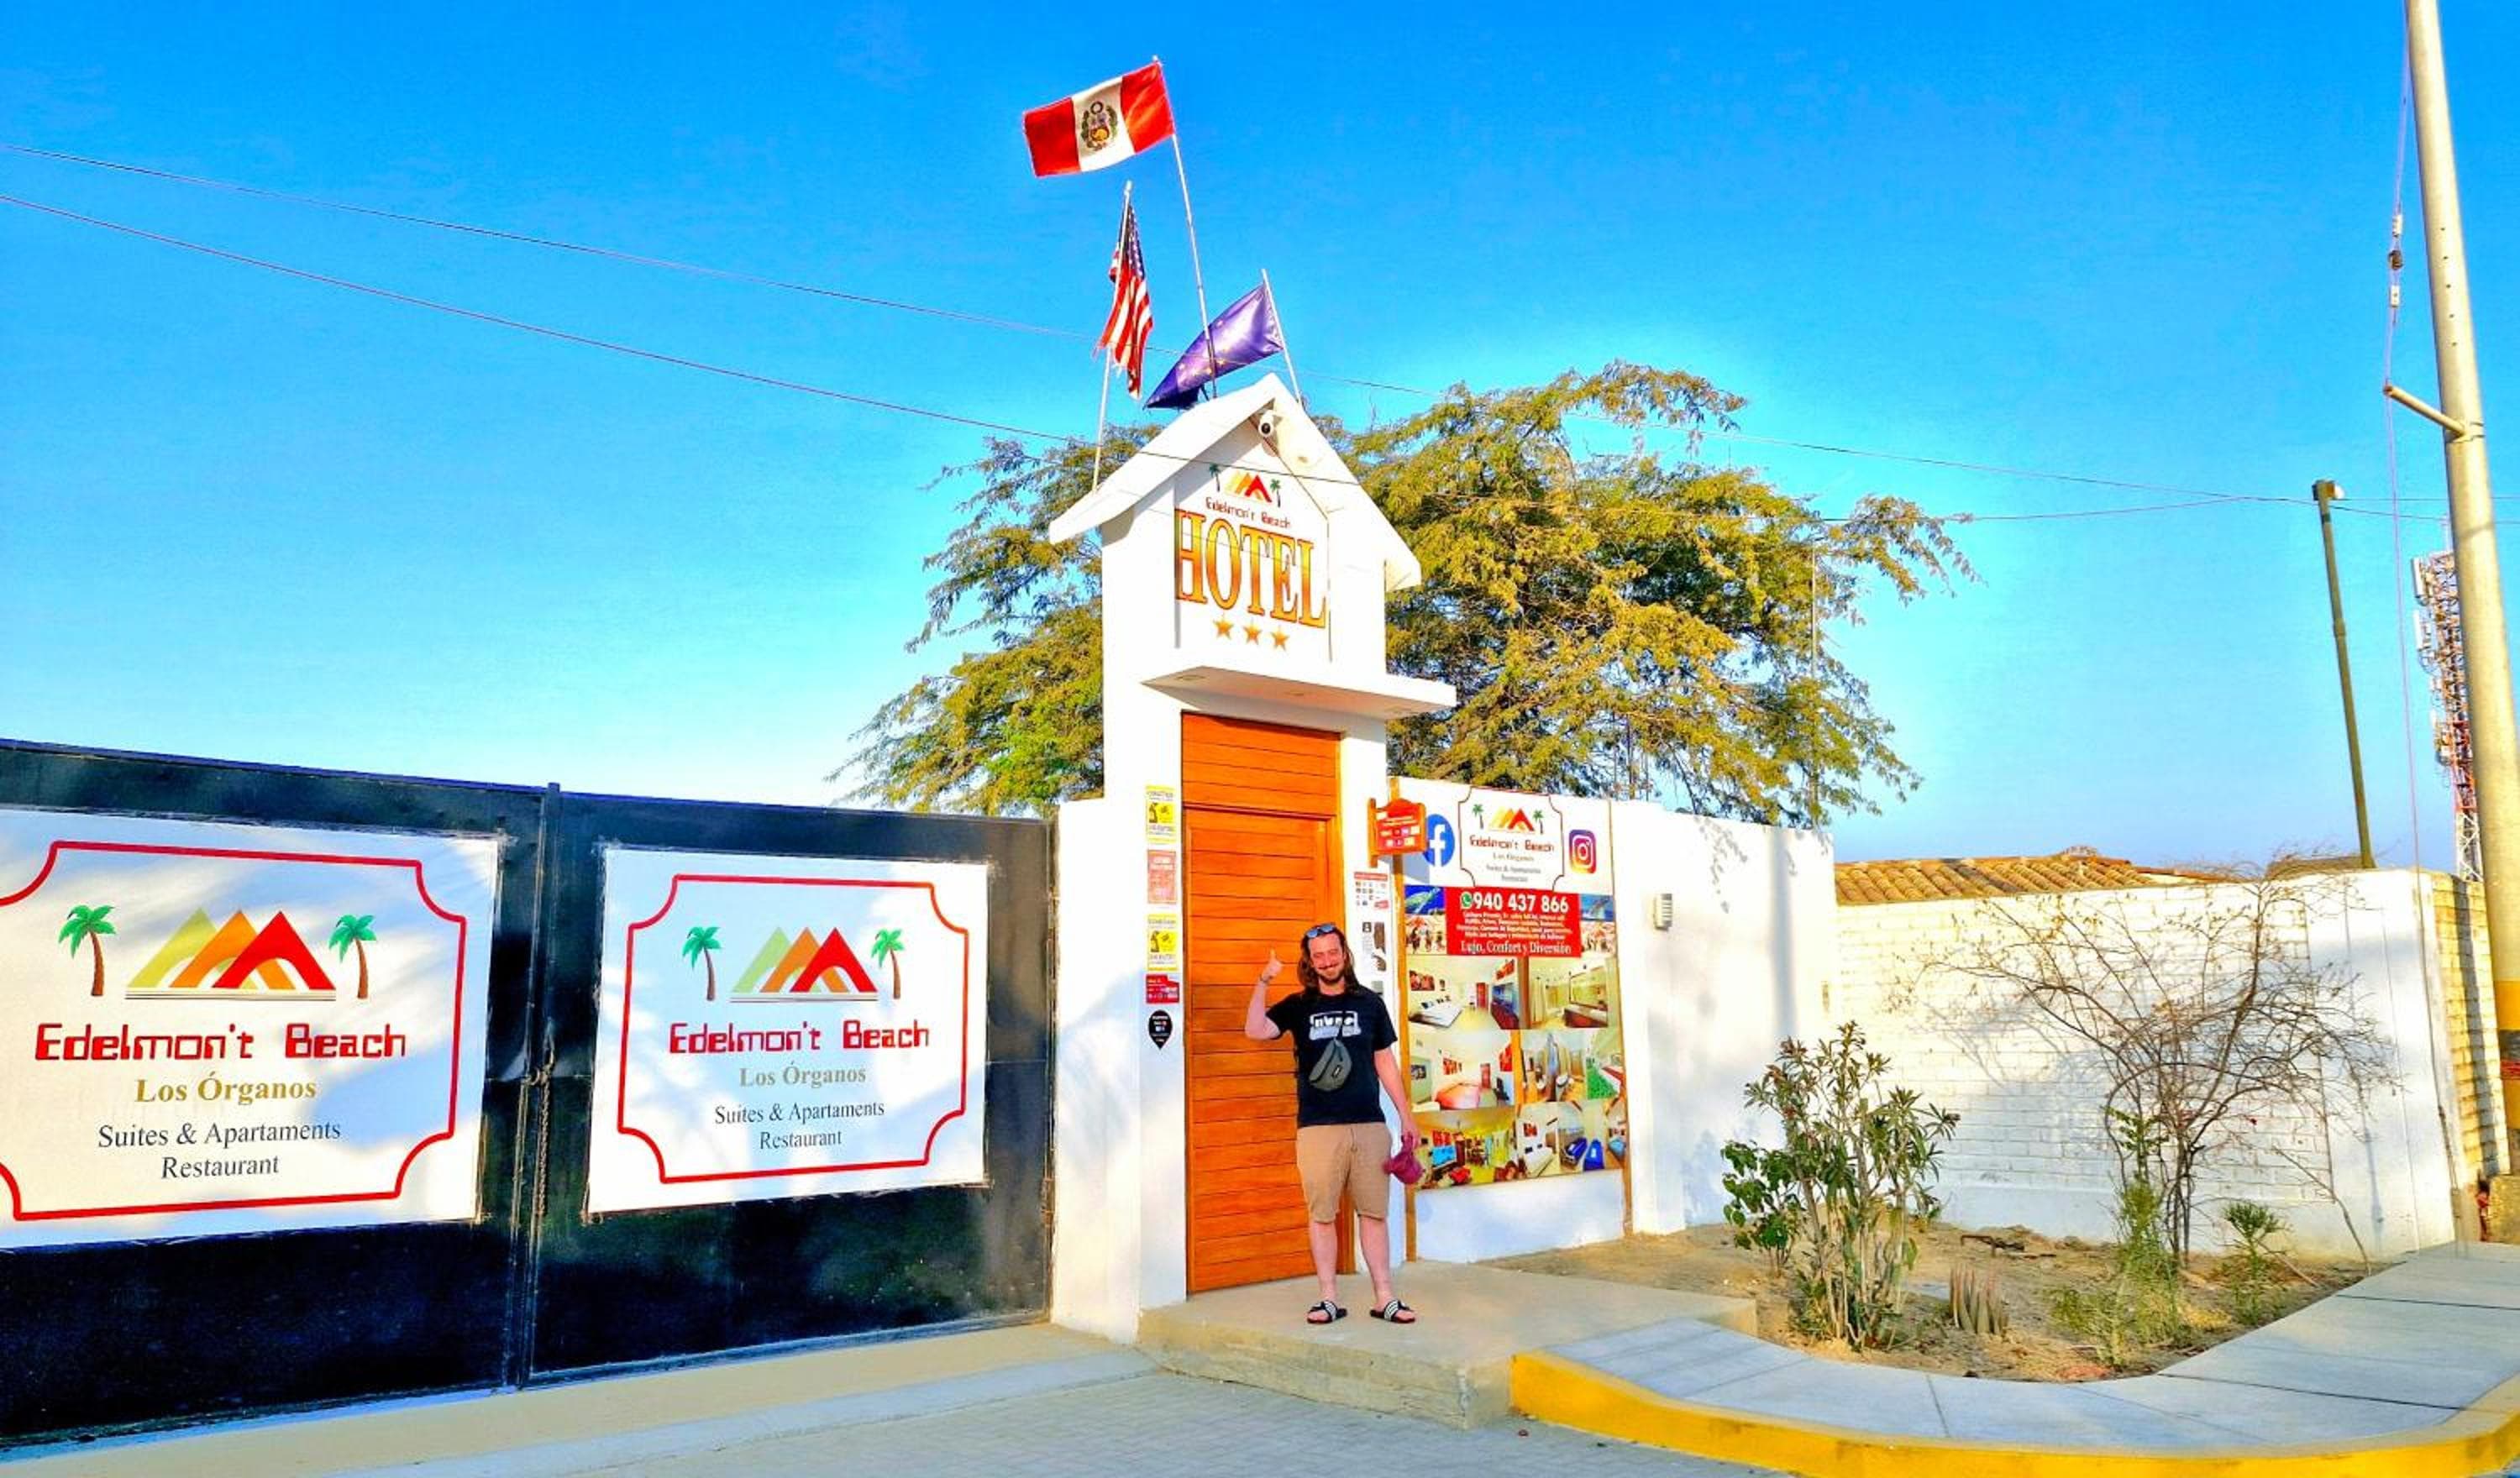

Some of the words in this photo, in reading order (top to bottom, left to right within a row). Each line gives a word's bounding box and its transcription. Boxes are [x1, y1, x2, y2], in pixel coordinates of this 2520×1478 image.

[1174, 507, 1326, 629] HOTEL
[1473, 892, 1503, 910] 940
[1508, 894, 1536, 911] 437
[1541, 895, 1568, 913] 866
[35, 1023, 254, 1061] Edelmon't
[285, 1023, 406, 1058] Beach
[669, 1021, 821, 1054] Edelmon't
[843, 1019, 930, 1049] Beach
[135, 1078, 187, 1103] Los
[198, 1072, 317, 1105] Órganos
[739, 1067, 776, 1088] Los
[783, 1061, 866, 1089] Órganos
[715, 1106, 764, 1124] Suites
[769, 1104, 782, 1121] &
[789, 1102, 885, 1124] Apartaments
[98, 1124, 168, 1147] Suites
[176, 1123, 197, 1145] &
[204, 1120, 341, 1148] Apartaments
[760, 1131, 842, 1150] Restaurant
[161, 1155, 280, 1179] Restaurant
